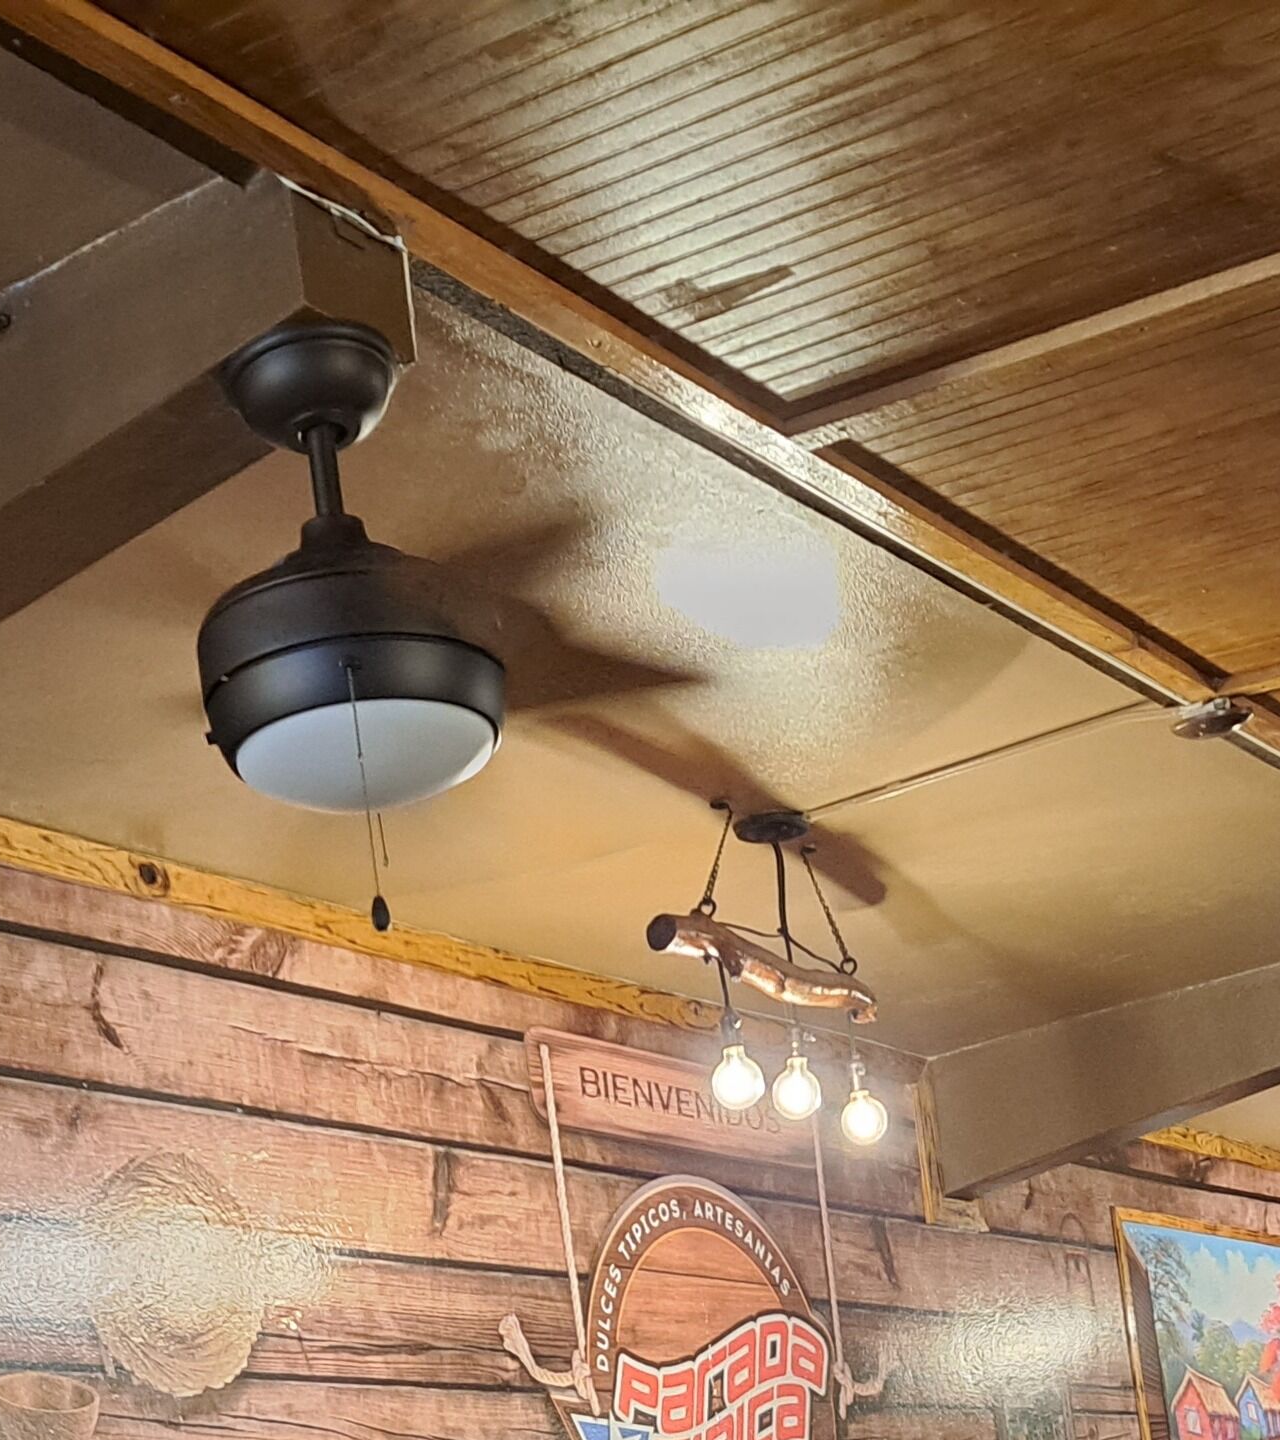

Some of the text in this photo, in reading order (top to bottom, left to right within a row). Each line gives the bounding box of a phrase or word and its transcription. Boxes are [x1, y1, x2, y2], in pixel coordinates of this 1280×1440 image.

[596, 1199, 790, 1372] DULCES TIPICOS, ARTESANIAS
